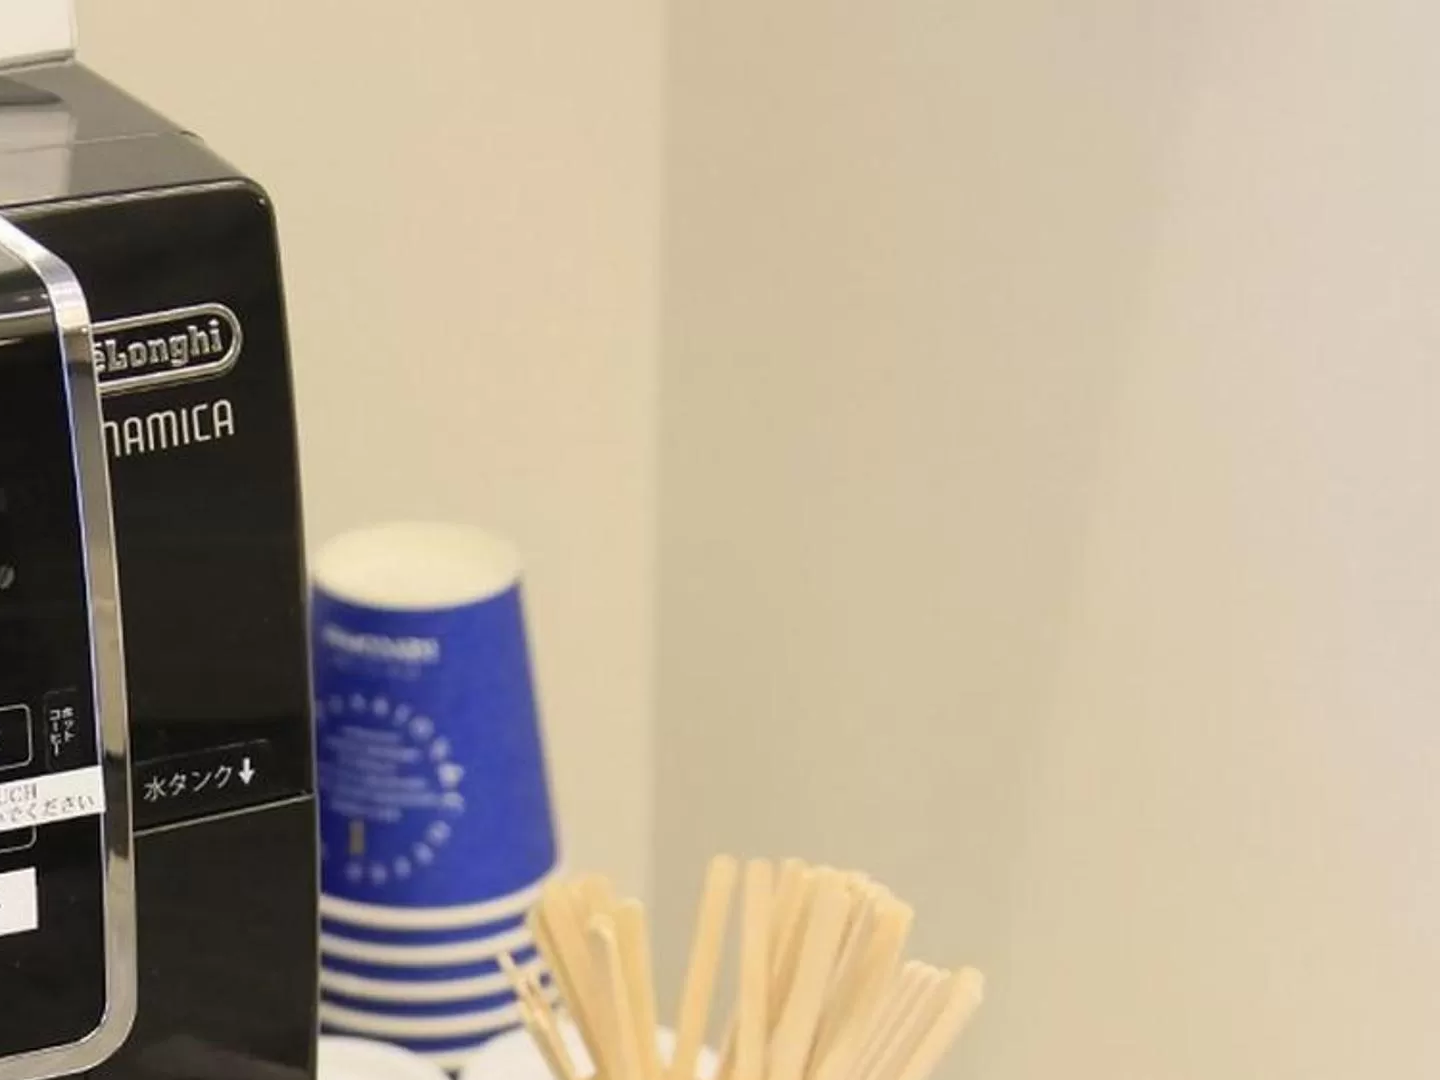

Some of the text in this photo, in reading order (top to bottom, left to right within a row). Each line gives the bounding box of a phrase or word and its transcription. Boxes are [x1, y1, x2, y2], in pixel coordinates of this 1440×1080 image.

[103, 399, 234, 457] NAMICA
[144, 765, 232, 802] 水タンク
